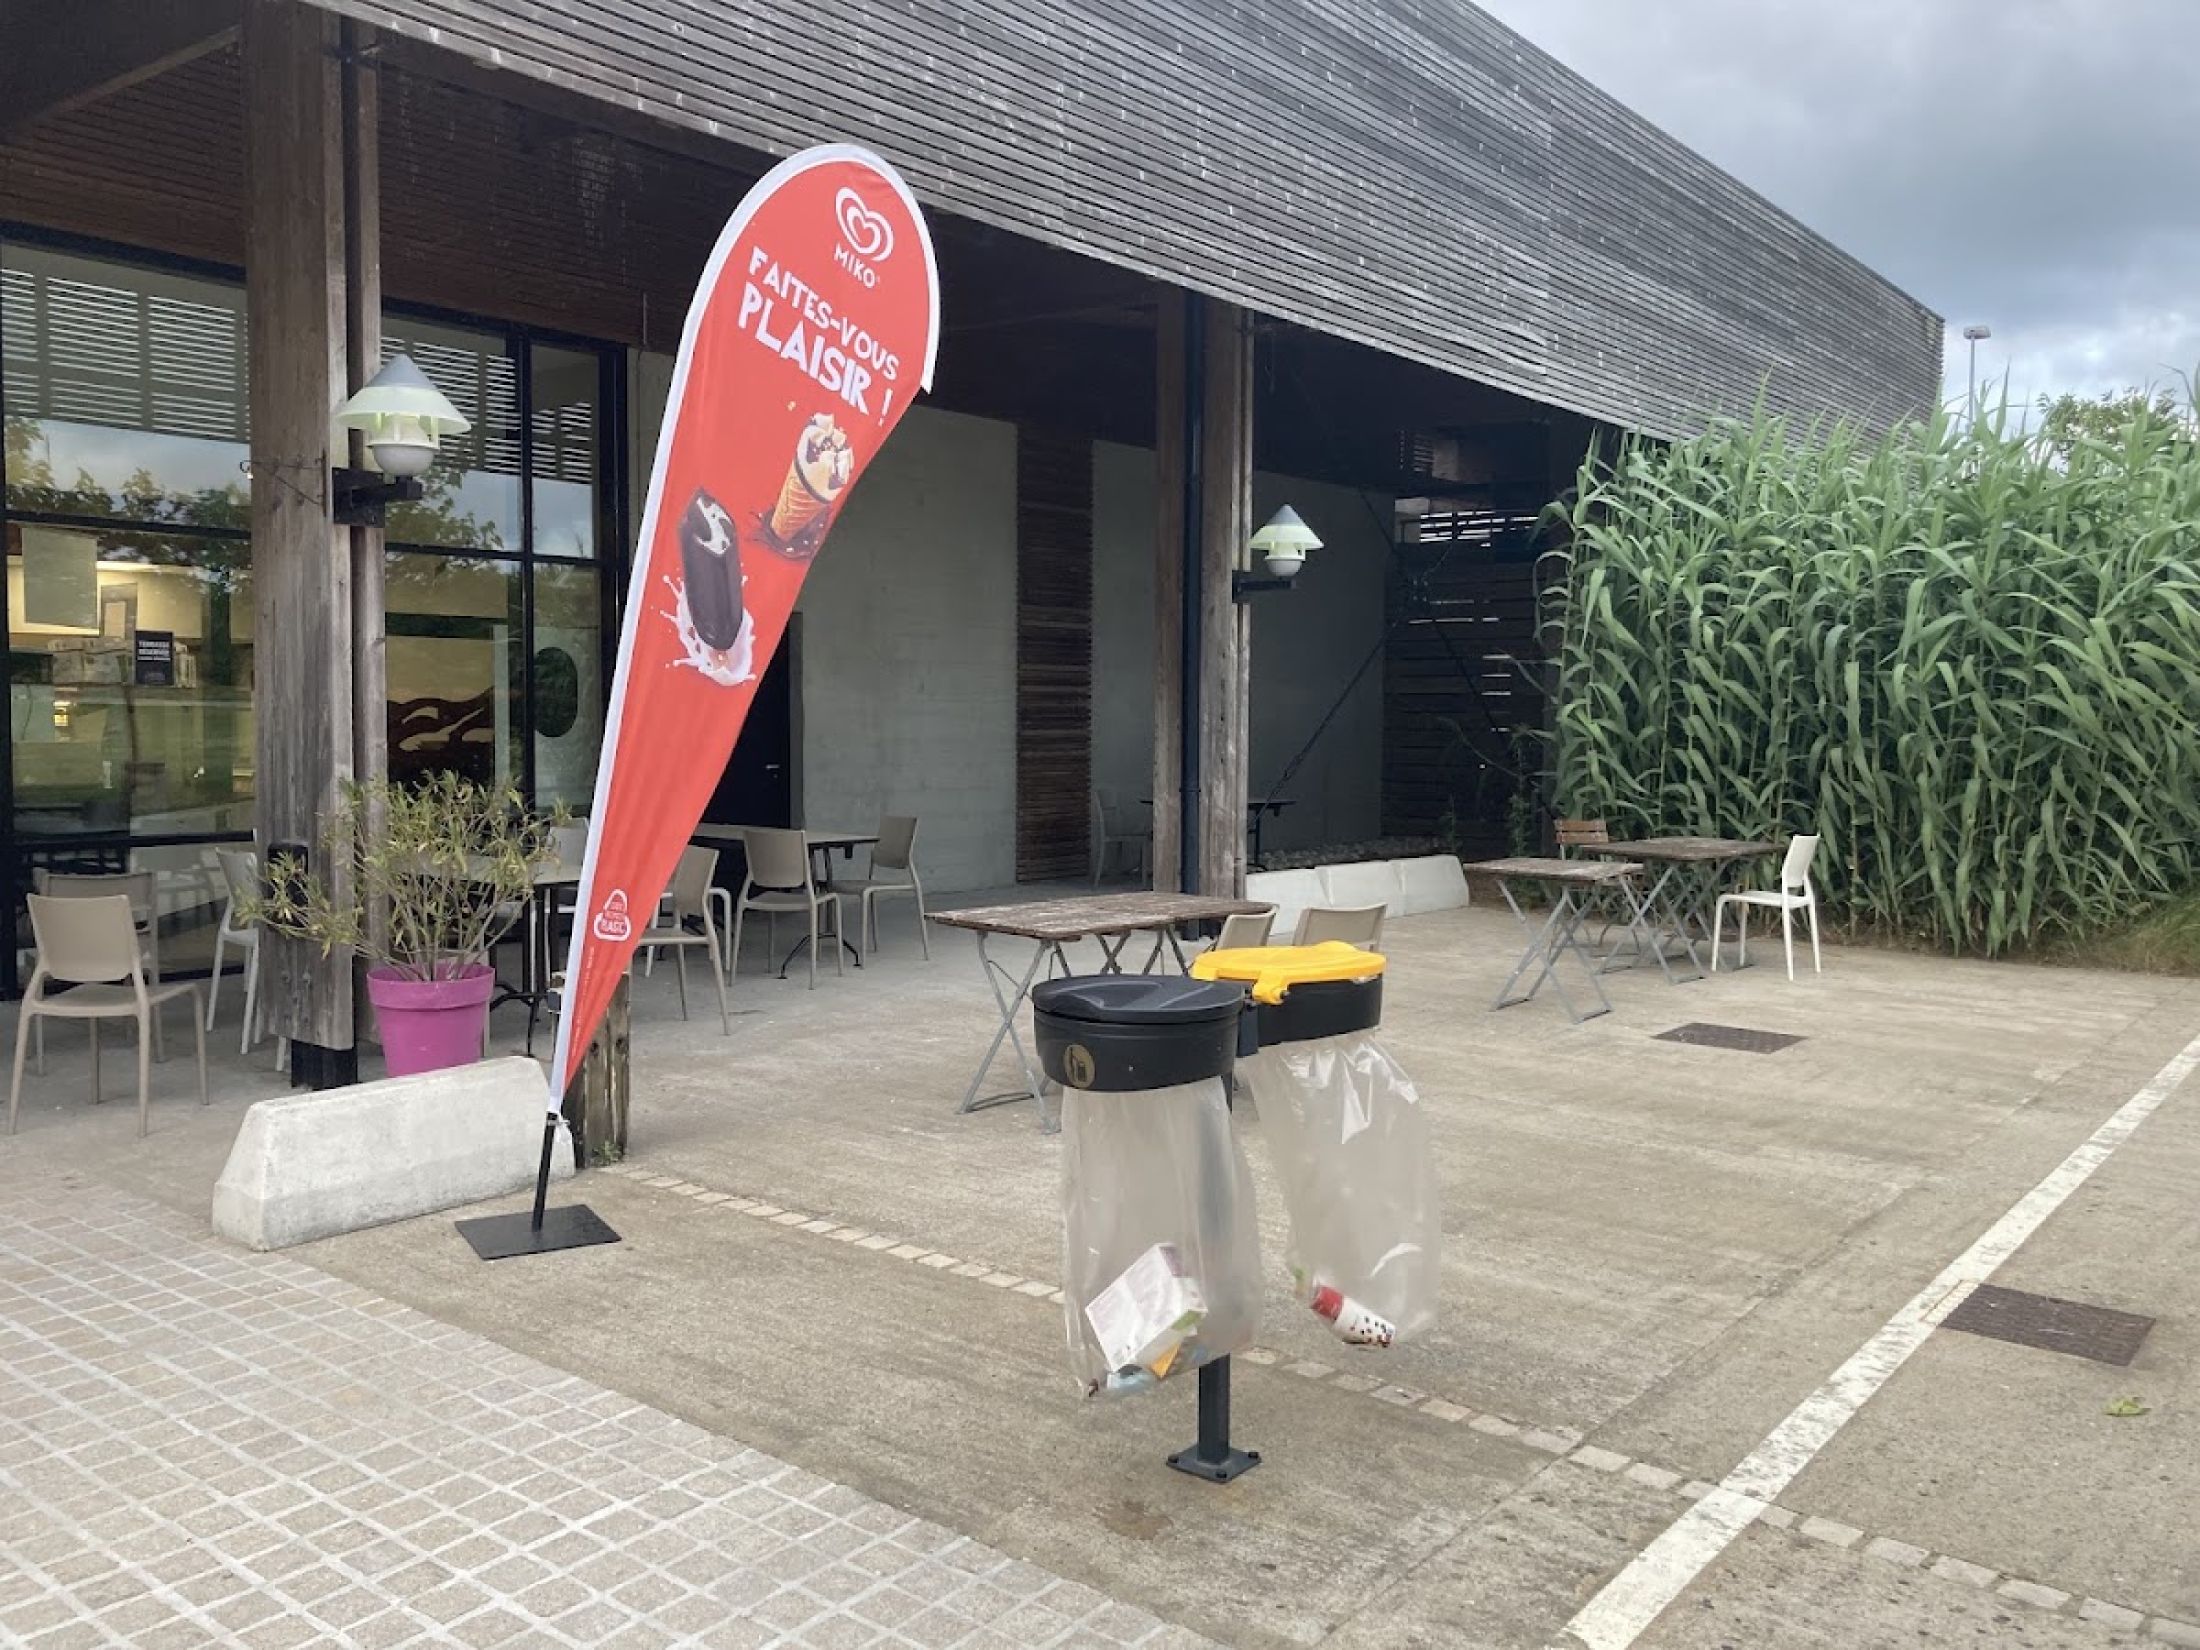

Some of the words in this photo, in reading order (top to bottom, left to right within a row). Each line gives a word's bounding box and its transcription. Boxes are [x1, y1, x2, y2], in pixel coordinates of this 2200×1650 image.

[748, 246, 900, 381] FAITES-VOUS
[833, 243, 876, 288] MIKO
[738, 281, 871, 414] PLAISIR
[877, 388, 894, 426] !
